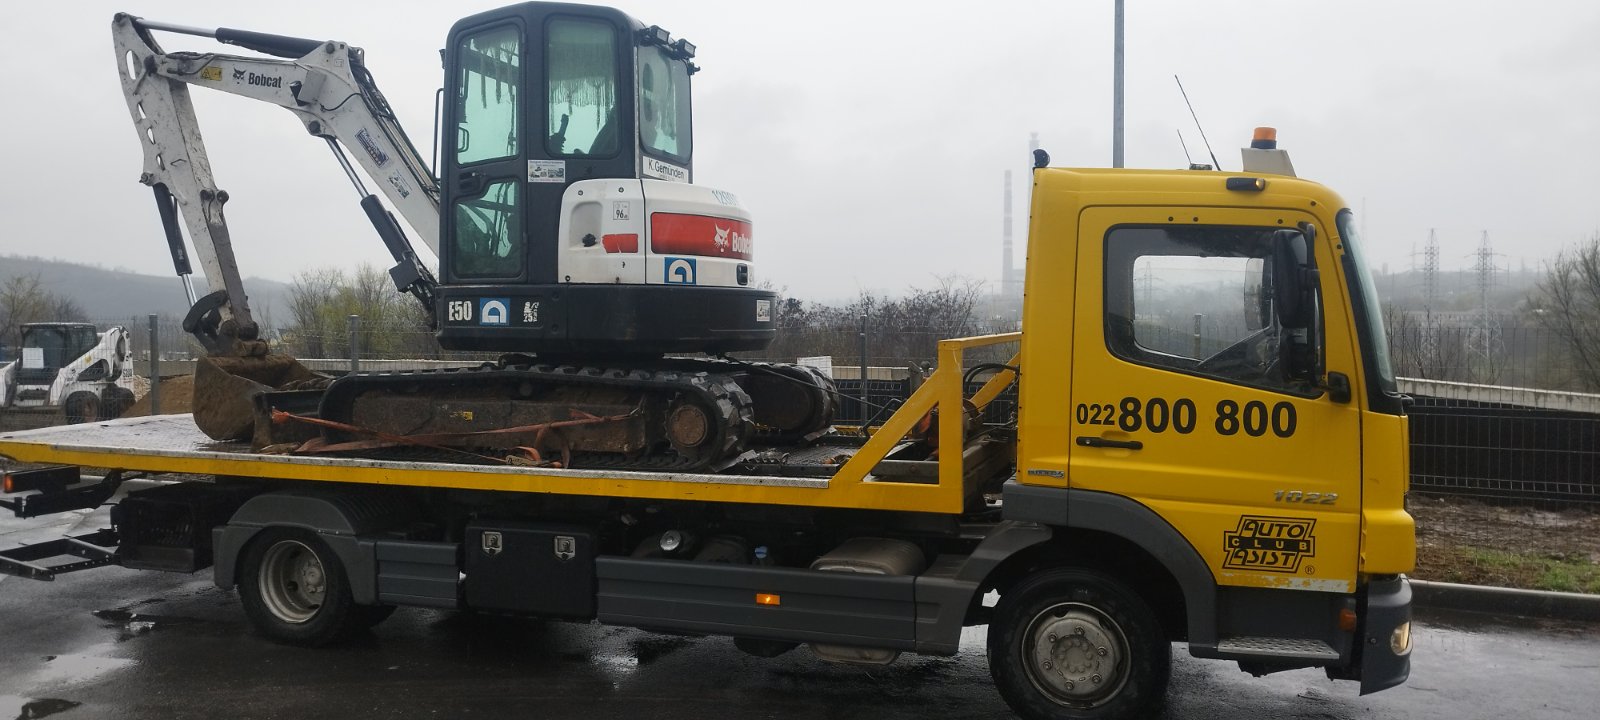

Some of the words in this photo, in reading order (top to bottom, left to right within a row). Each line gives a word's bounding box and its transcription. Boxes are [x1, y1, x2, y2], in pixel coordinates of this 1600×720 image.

[248, 72, 282, 88] Bobcat
[655, 161, 684, 179] Gemünden
[615, 209, 624, 219] 96
[448, 300, 473, 321] E50
[1076, 403, 1115, 426] 022
[1118, 396, 1197, 435] 800
[1215, 399, 1297, 438] 800
[1274, 489, 1338, 505] 1022
[1243, 521, 1305, 538] AUTO
[1231, 538, 1308, 551] CLUB
[1233, 548, 1296, 566] ASIST
